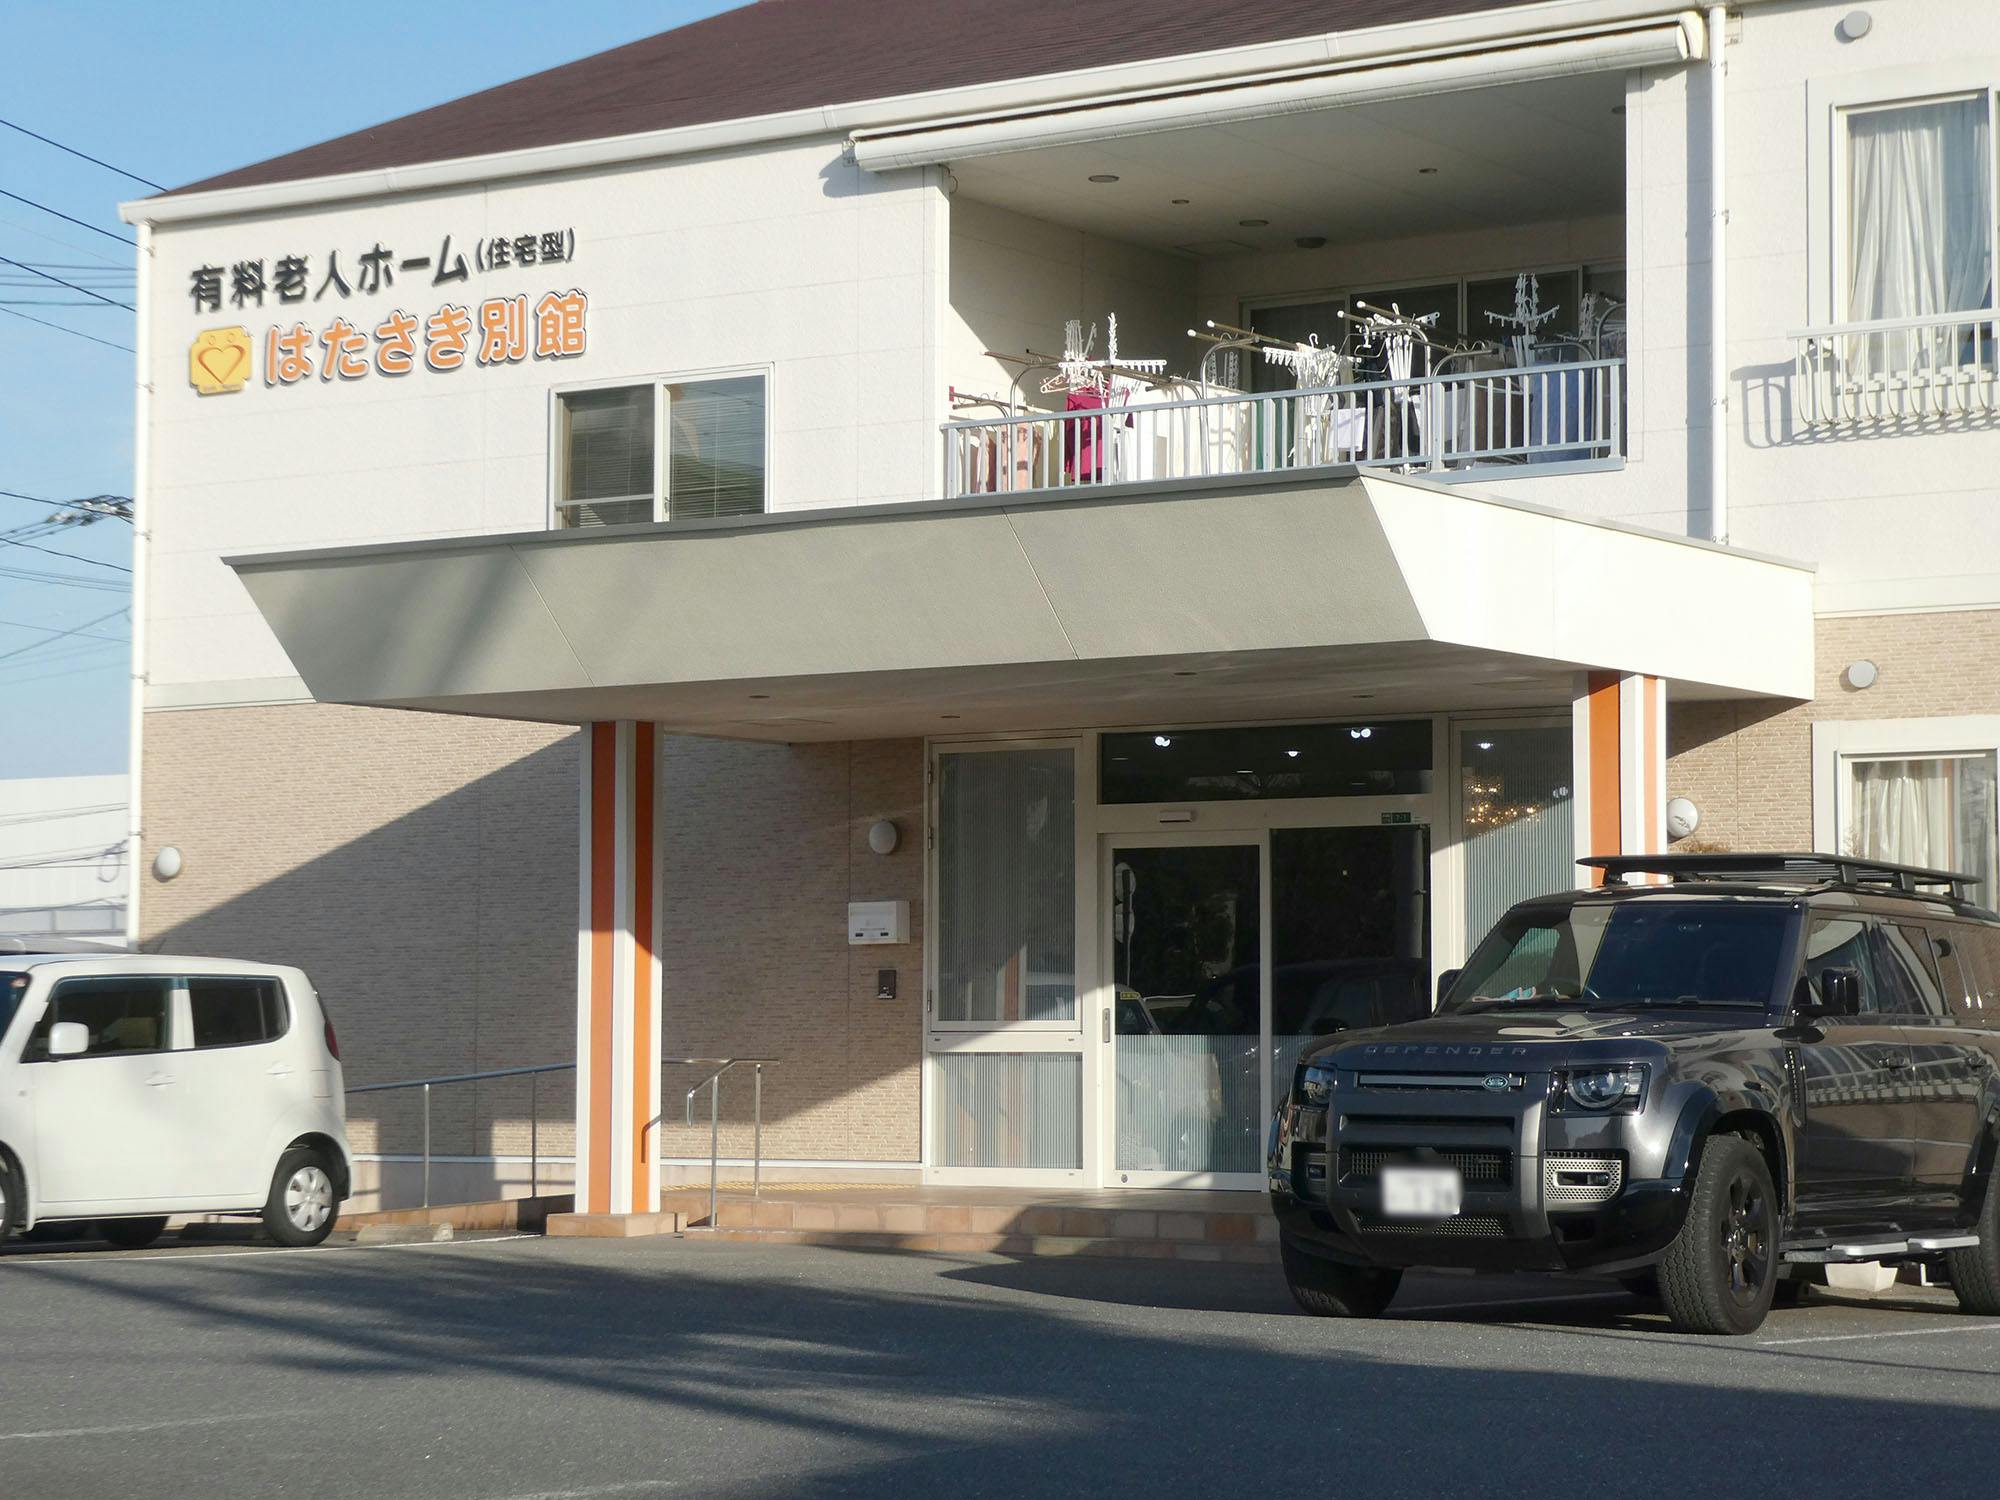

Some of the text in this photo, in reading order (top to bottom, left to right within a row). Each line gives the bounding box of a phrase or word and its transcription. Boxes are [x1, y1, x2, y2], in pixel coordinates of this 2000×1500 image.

[265, 289, 588, 388] はたさき別館
[1365, 1046, 1527, 1056] DEFENDER
